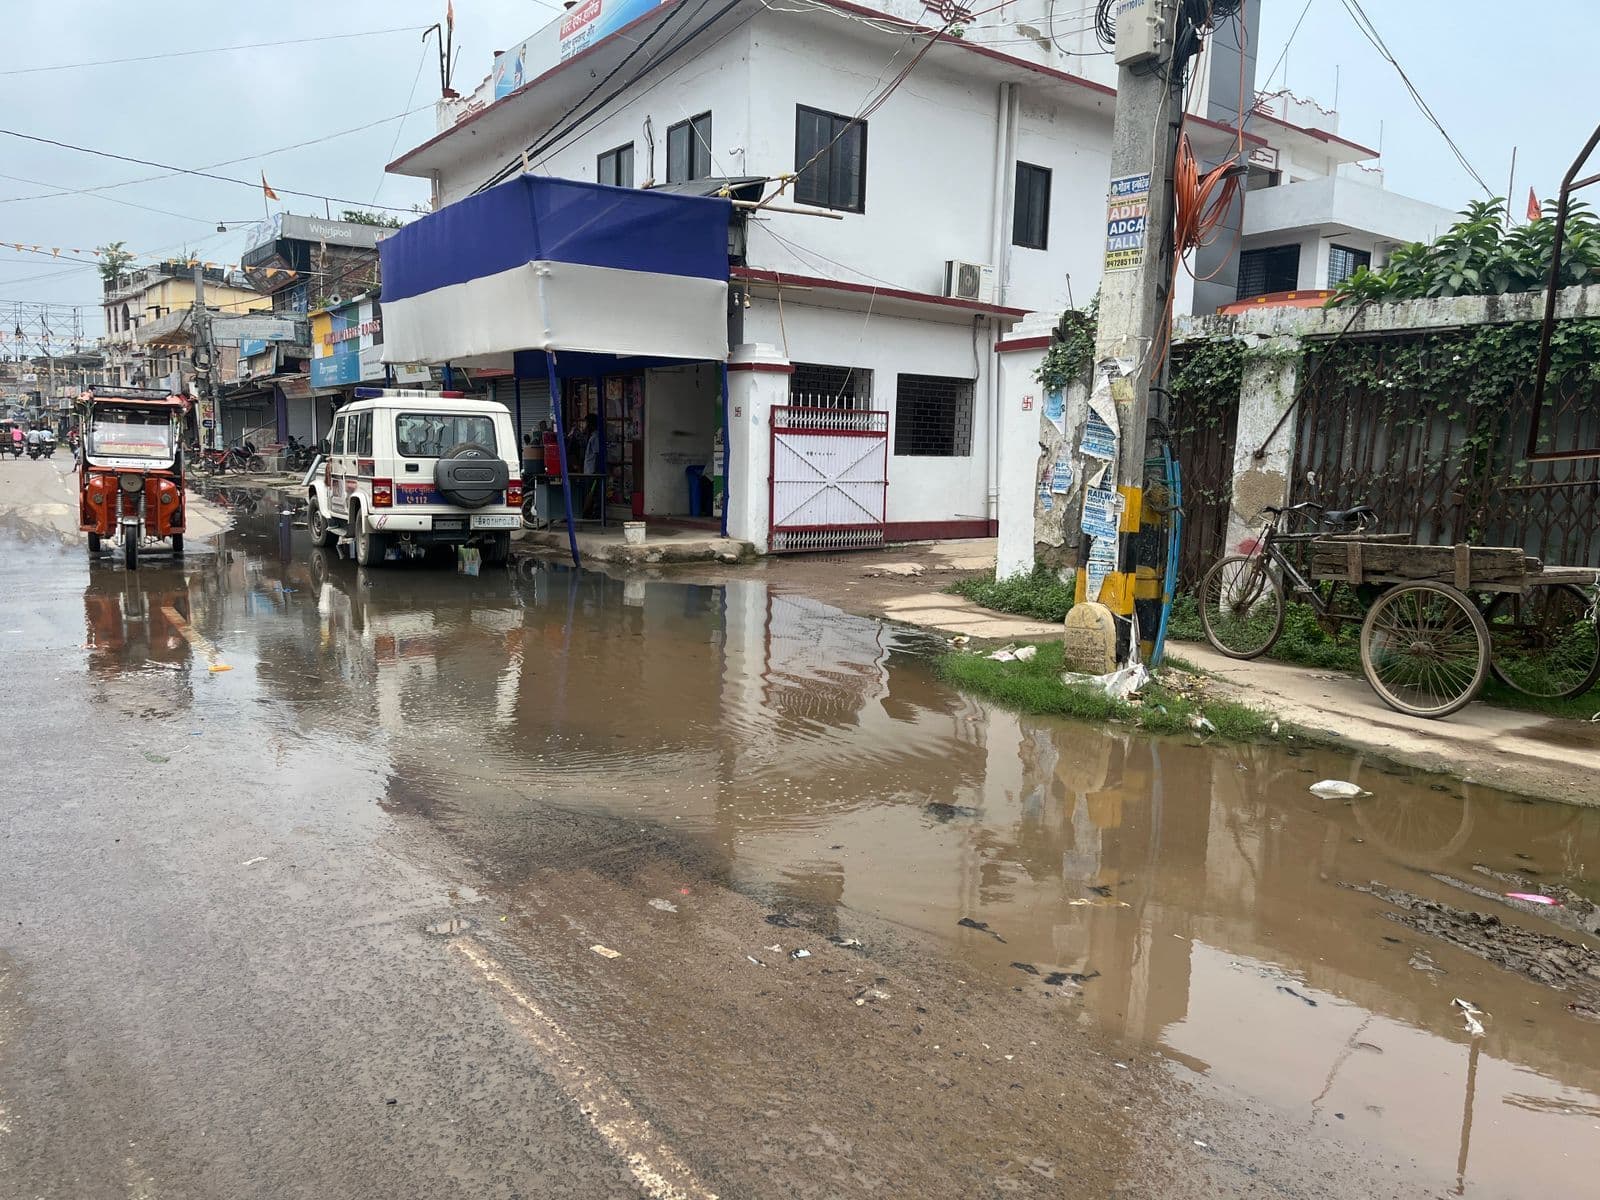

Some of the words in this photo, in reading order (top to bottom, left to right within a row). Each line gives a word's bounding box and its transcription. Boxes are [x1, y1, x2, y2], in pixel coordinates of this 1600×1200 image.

[1109, 204, 1146, 221] ADIT
[309, 223, 352, 239] Whirlpool
[1109, 219, 1145, 235] ADCA
[1109, 235, 1143, 250] TALLY
[415, 496, 428, 504] 112
